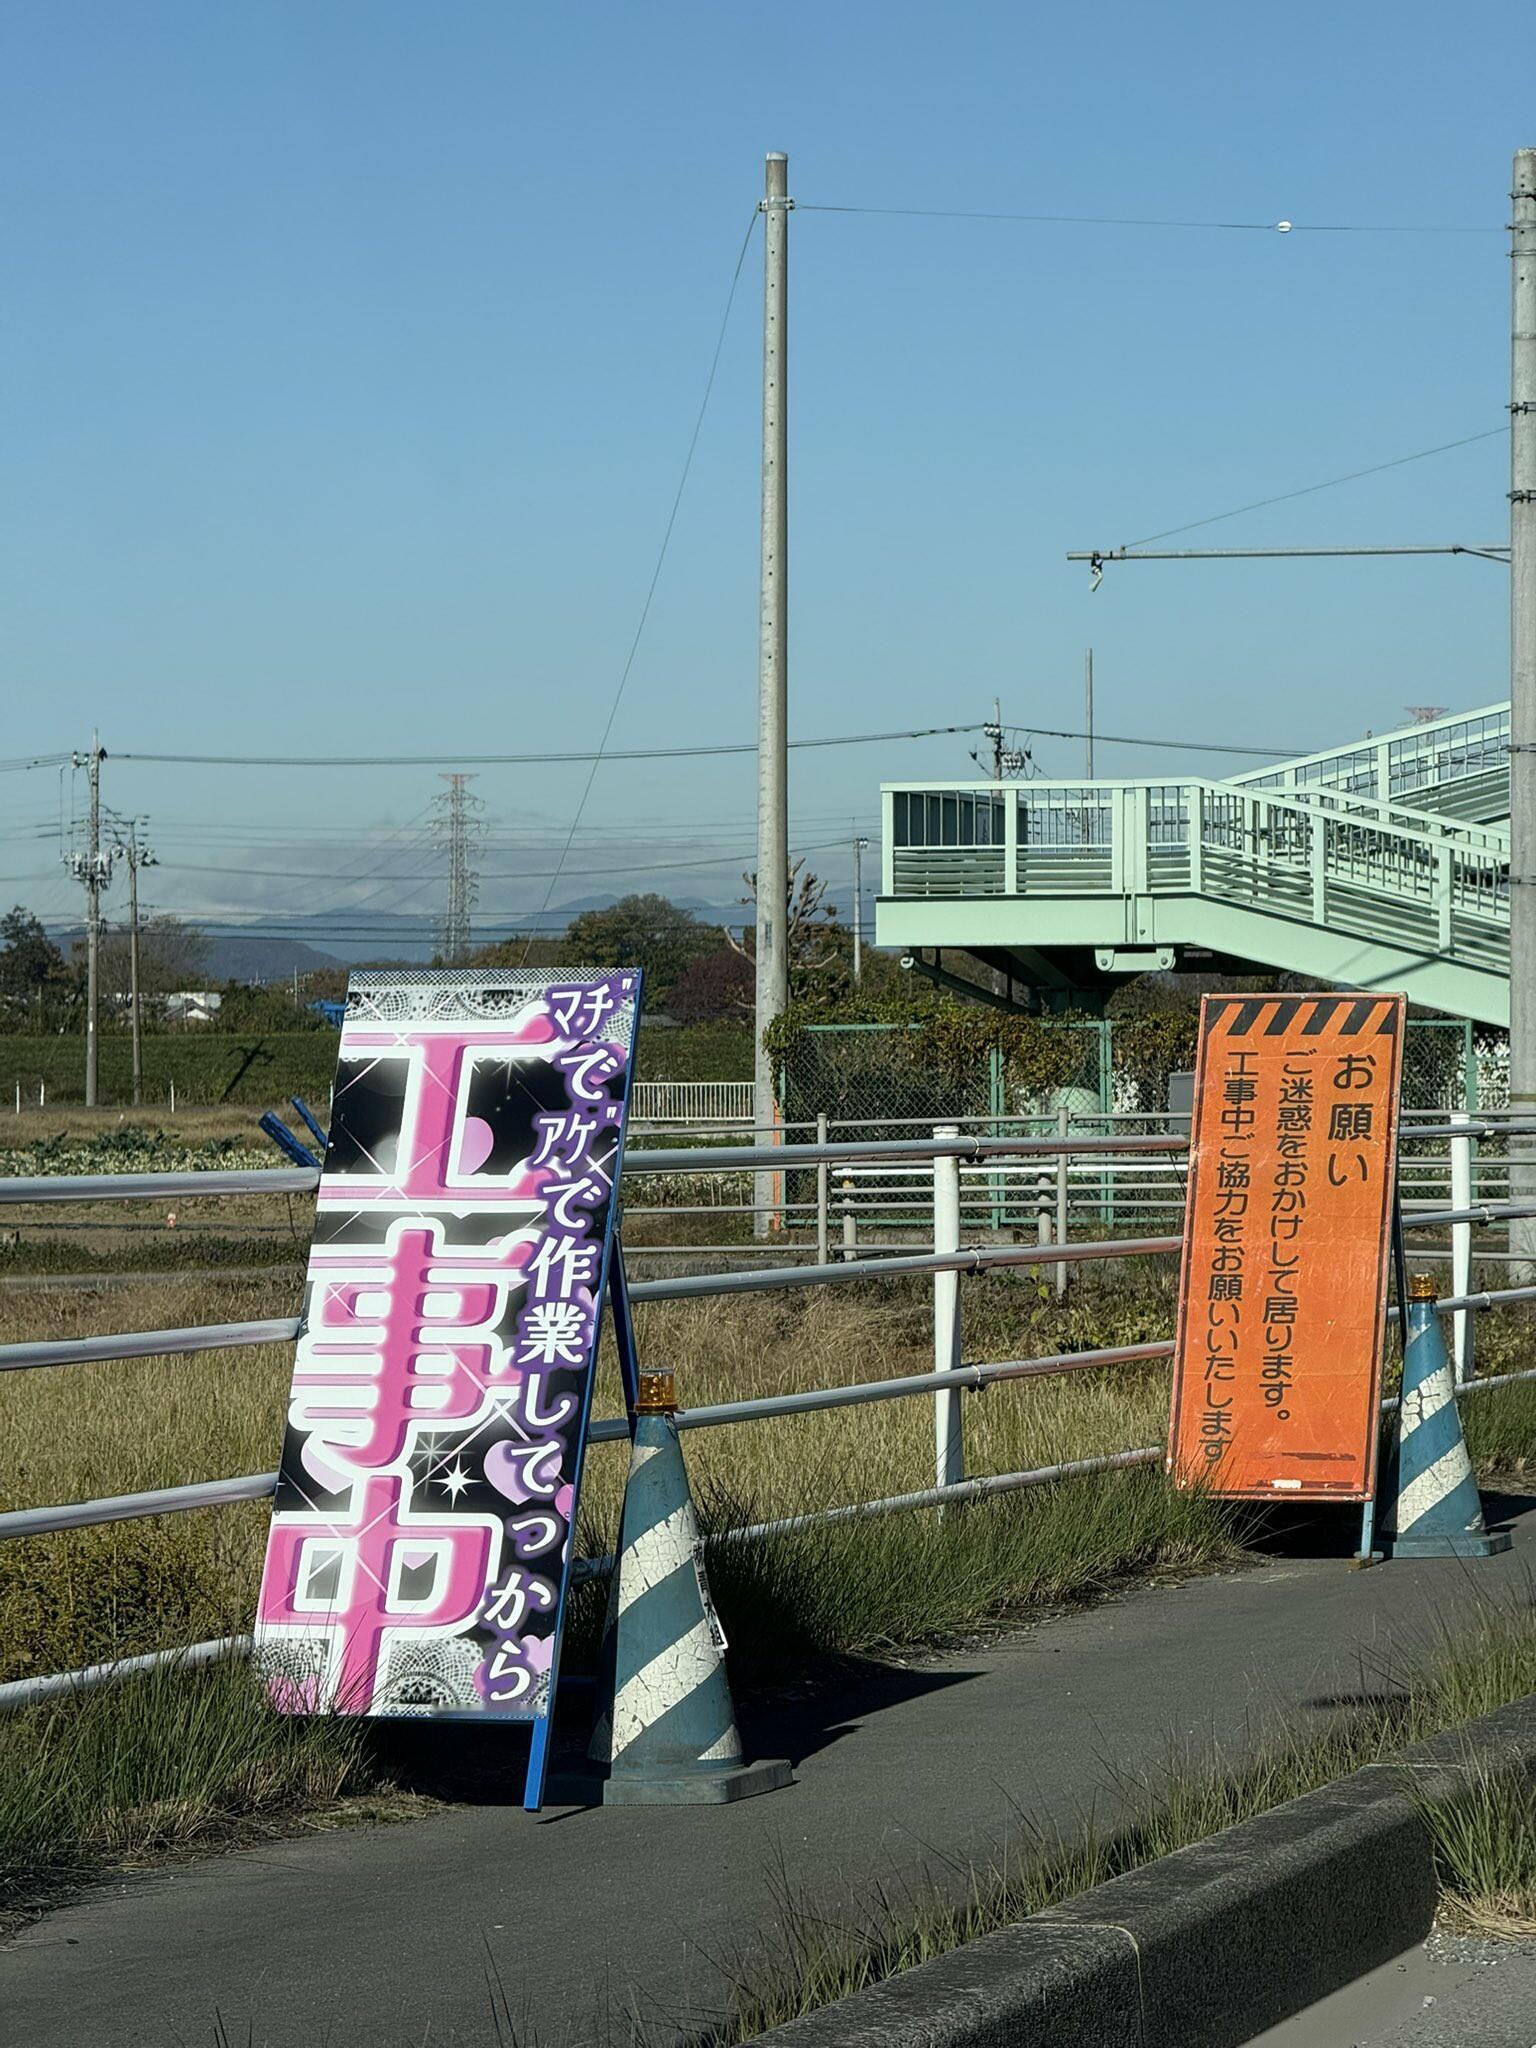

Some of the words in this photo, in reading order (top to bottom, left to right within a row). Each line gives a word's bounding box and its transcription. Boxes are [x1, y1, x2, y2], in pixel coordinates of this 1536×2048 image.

[1199, 1051, 1259, 1463] 工事中ご協力をお願いいたします
[1259, 1048, 1317, 1421] ご迷惑をおかけして居ります。
[1328, 1053, 1376, 1187] お願い
[254, 1012, 563, 1716] 工事中
